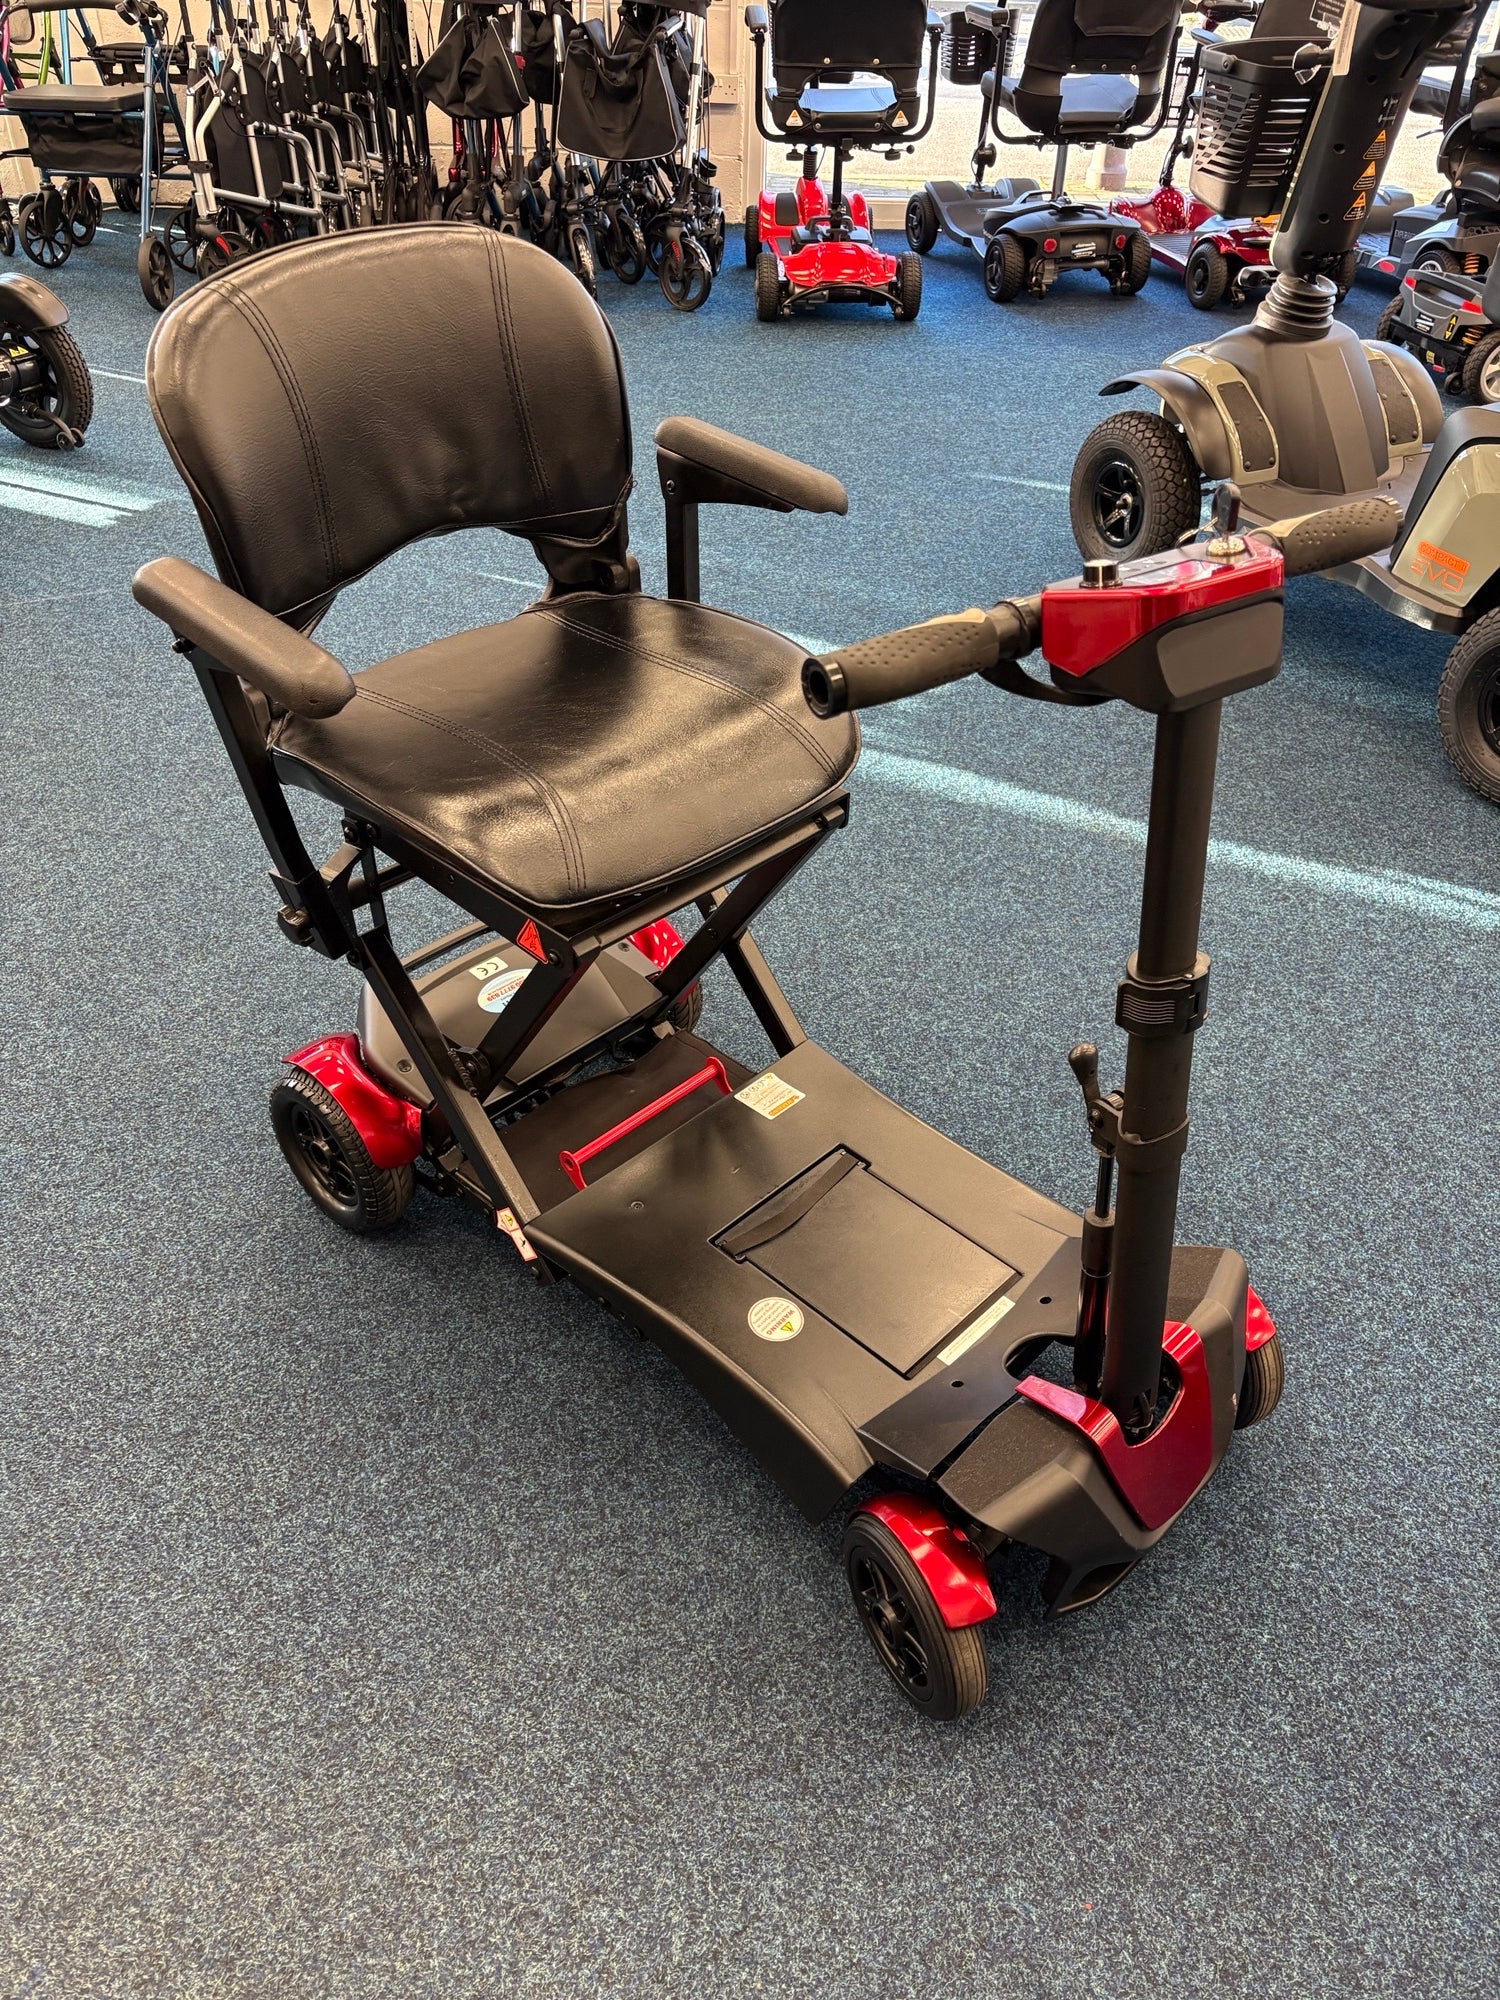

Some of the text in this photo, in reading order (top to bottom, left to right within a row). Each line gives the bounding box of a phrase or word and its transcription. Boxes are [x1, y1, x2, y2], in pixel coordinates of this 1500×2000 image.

[1421, 543, 1459, 569] COMPACT
[1411, 557, 1464, 593] EVO
[477, 962, 499, 976] CE
[766, 1309, 795, 1336] WARNING
